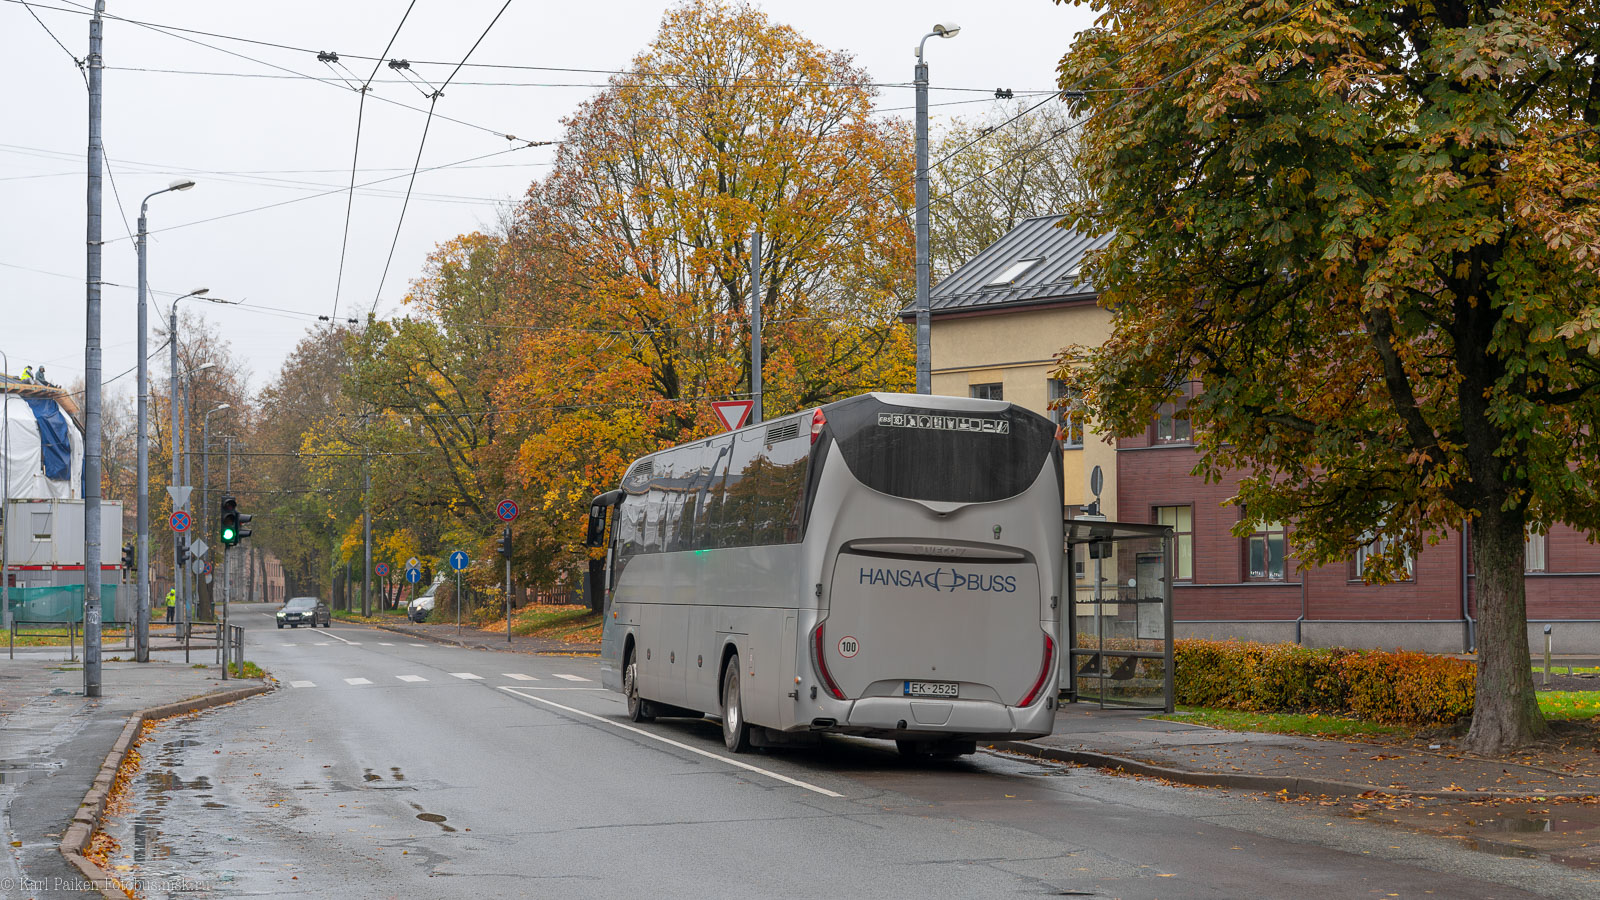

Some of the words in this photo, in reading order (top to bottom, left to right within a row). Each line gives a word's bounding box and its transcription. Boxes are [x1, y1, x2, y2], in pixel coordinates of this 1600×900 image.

[859, 567, 924, 588] HANSA
[967, 573, 1017, 593] BUSS
[842, 641, 857, 653] 100
[911, 683, 958, 695] EK-2525
